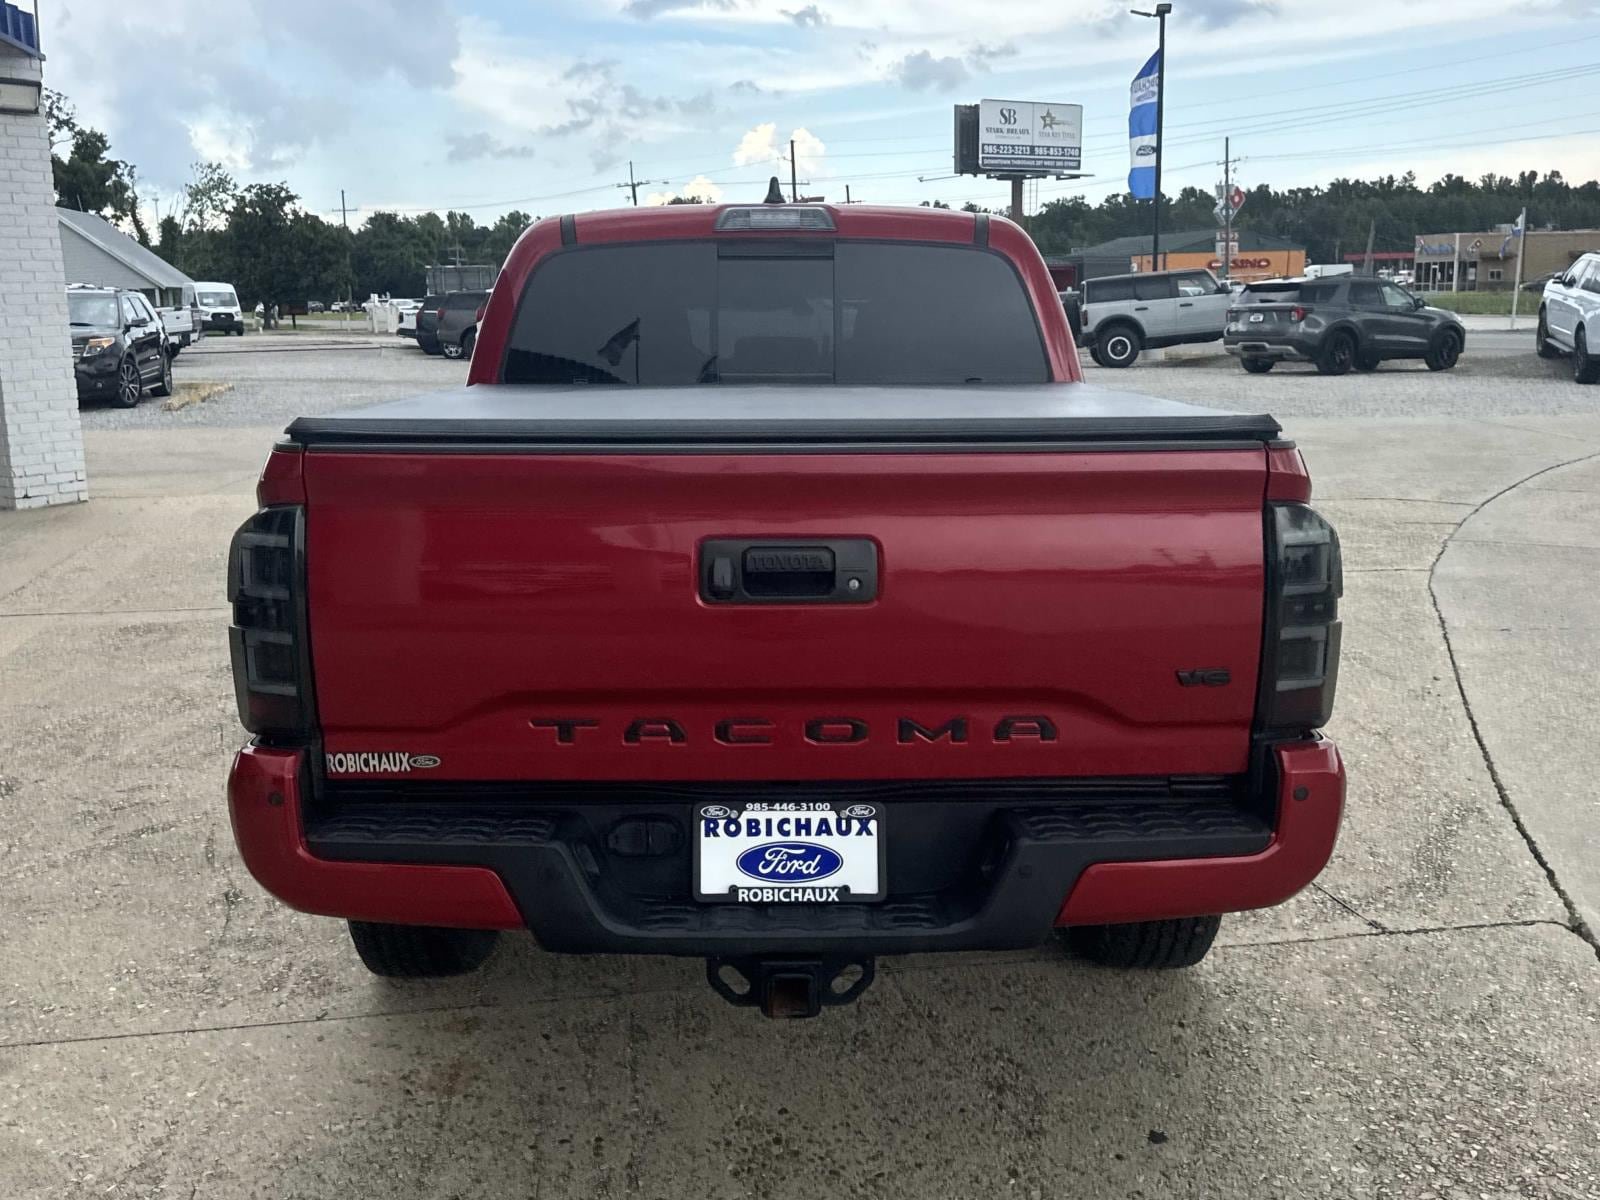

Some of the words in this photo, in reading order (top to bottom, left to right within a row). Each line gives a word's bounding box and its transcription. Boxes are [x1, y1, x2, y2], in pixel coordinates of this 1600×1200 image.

[983, 145, 1030, 154] 985-223-3213
[1208, 258, 1271, 270] CSINO
[1175, 667, 1231, 687] V6
[528, 716, 1058, 745] TACOMA
[325, 752, 411, 773] ROBICHAUX
[745, 802, 831, 812] 985-446-3100
[704, 818, 873, 837] ROBICHAUX
[758, 847, 822, 875] Ford
[738, 888, 840, 902] ROBICHAUX
